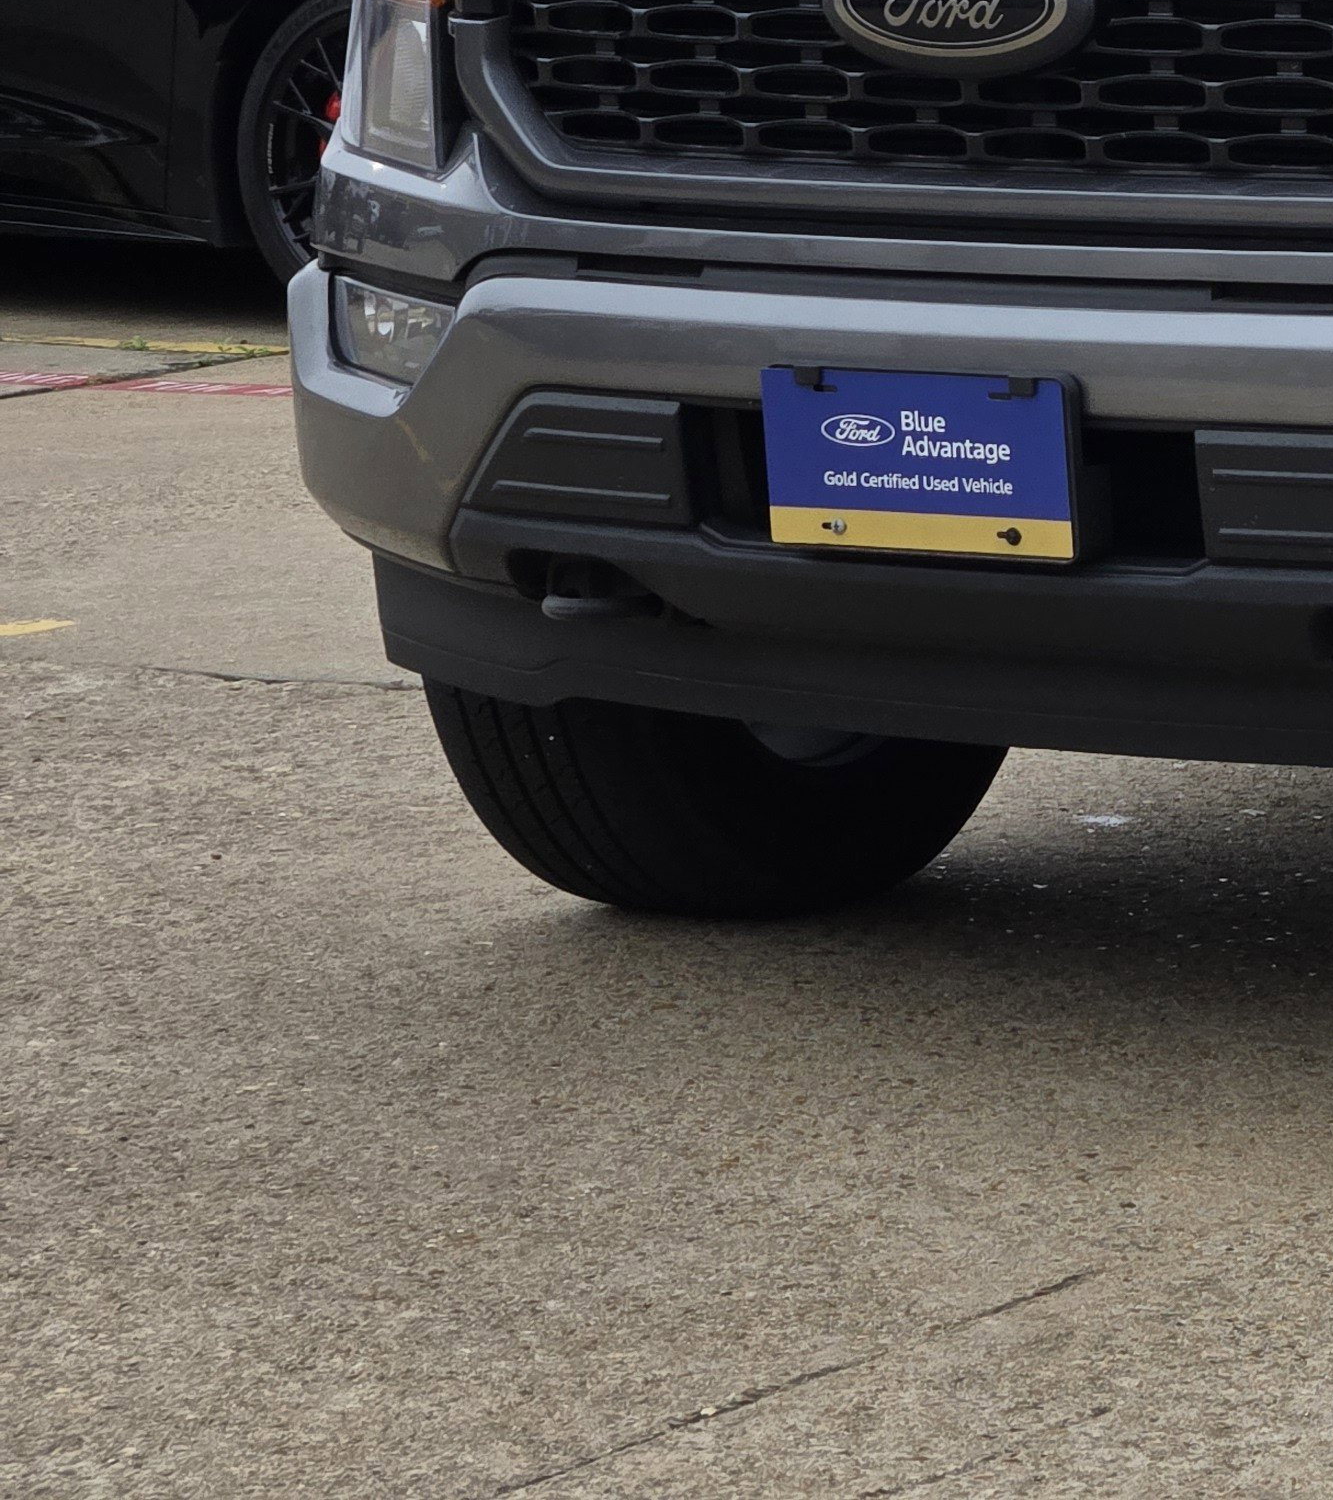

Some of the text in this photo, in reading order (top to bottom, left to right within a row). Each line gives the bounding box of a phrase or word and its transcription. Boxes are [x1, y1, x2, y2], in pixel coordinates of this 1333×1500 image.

[835, 417, 881, 443] Ford
[900, 410, 946, 433] Blue
[901, 435, 1011, 465] Advantage
[823, 470, 1014, 495] Gold Certified Used Vehicle
